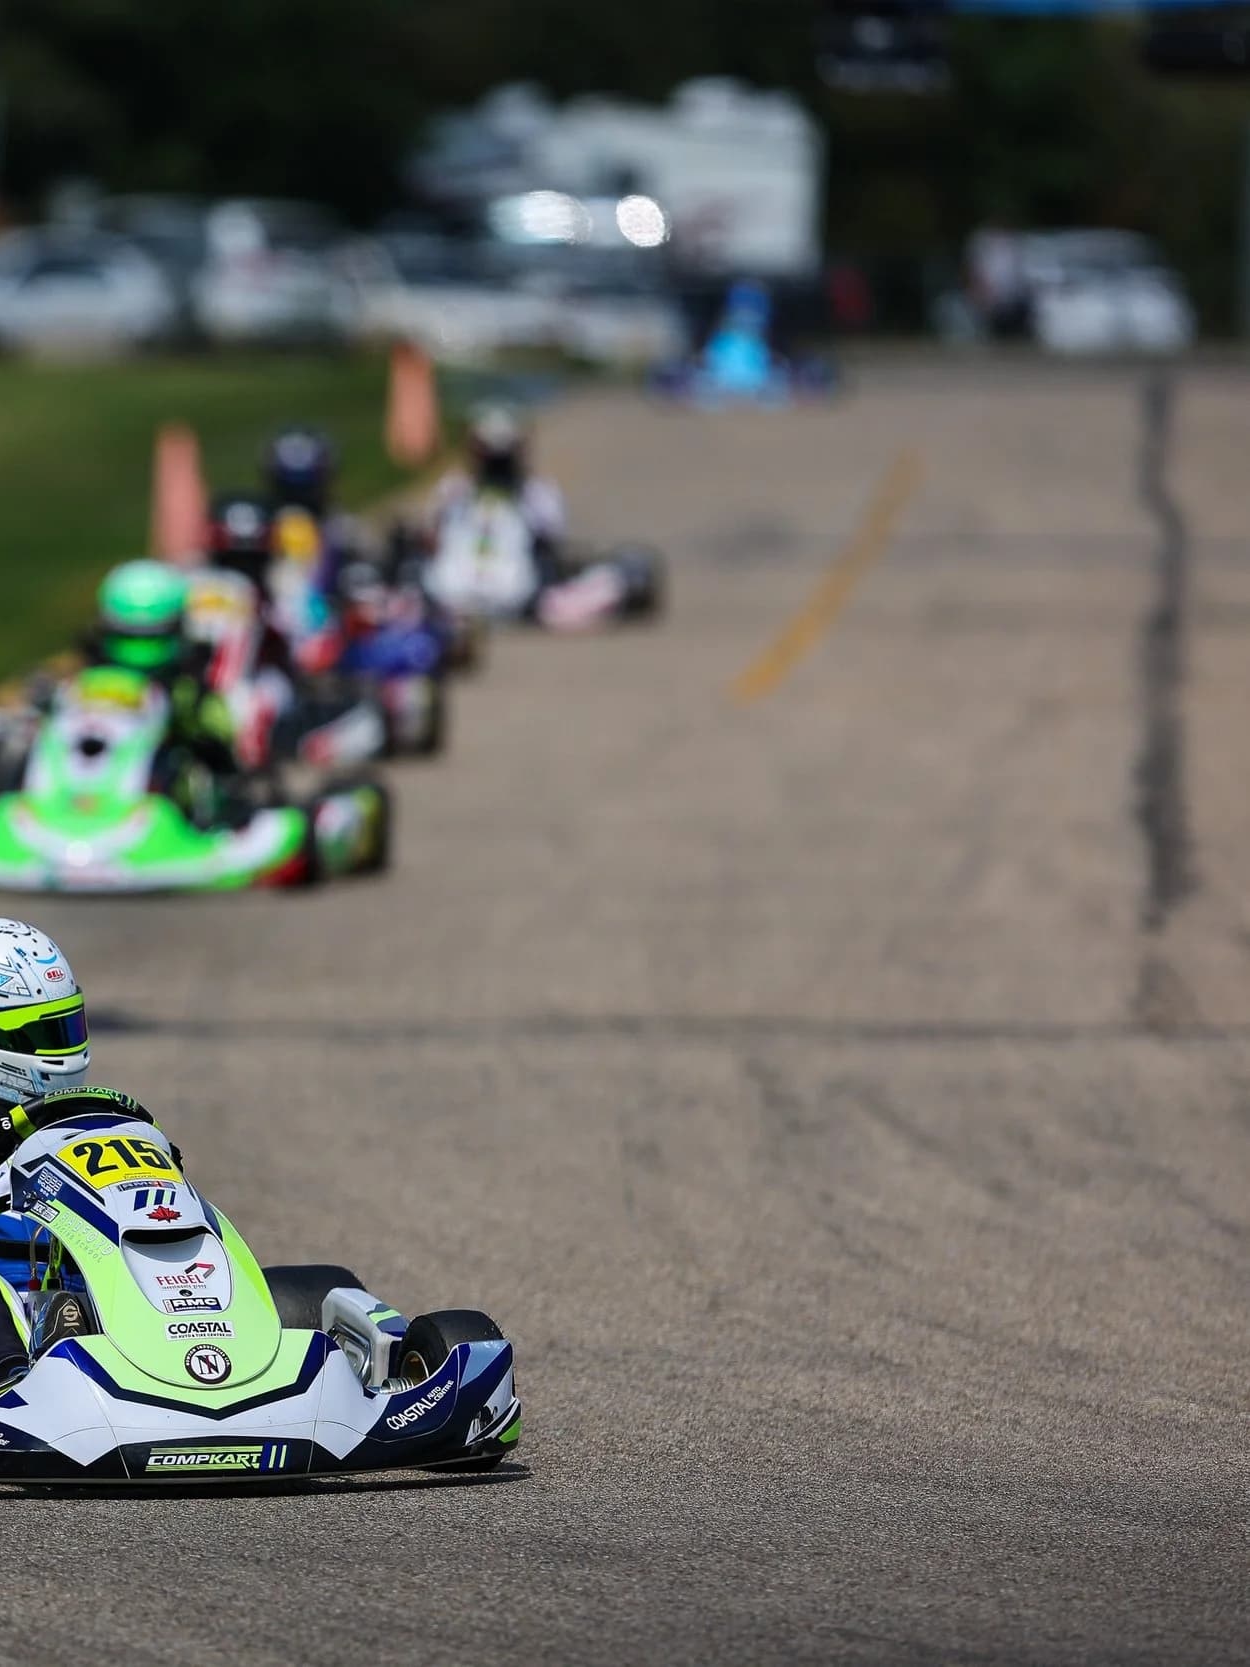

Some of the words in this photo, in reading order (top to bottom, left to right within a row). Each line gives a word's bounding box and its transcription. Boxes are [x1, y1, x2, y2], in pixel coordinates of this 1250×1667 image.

[46, 969, 65, 979] BELL
[73, 1138, 172, 1177] 215
[155, 1273, 205, 1286] FEIGEL
[171, 1298, 219, 1308] RMC
[168, 1321, 232, 1335] COASTAL
[386, 1396, 437, 1431] COASTAL
[426, 1385, 442, 1400] AUTO
[147, 1451, 262, 1470] COMPKART
